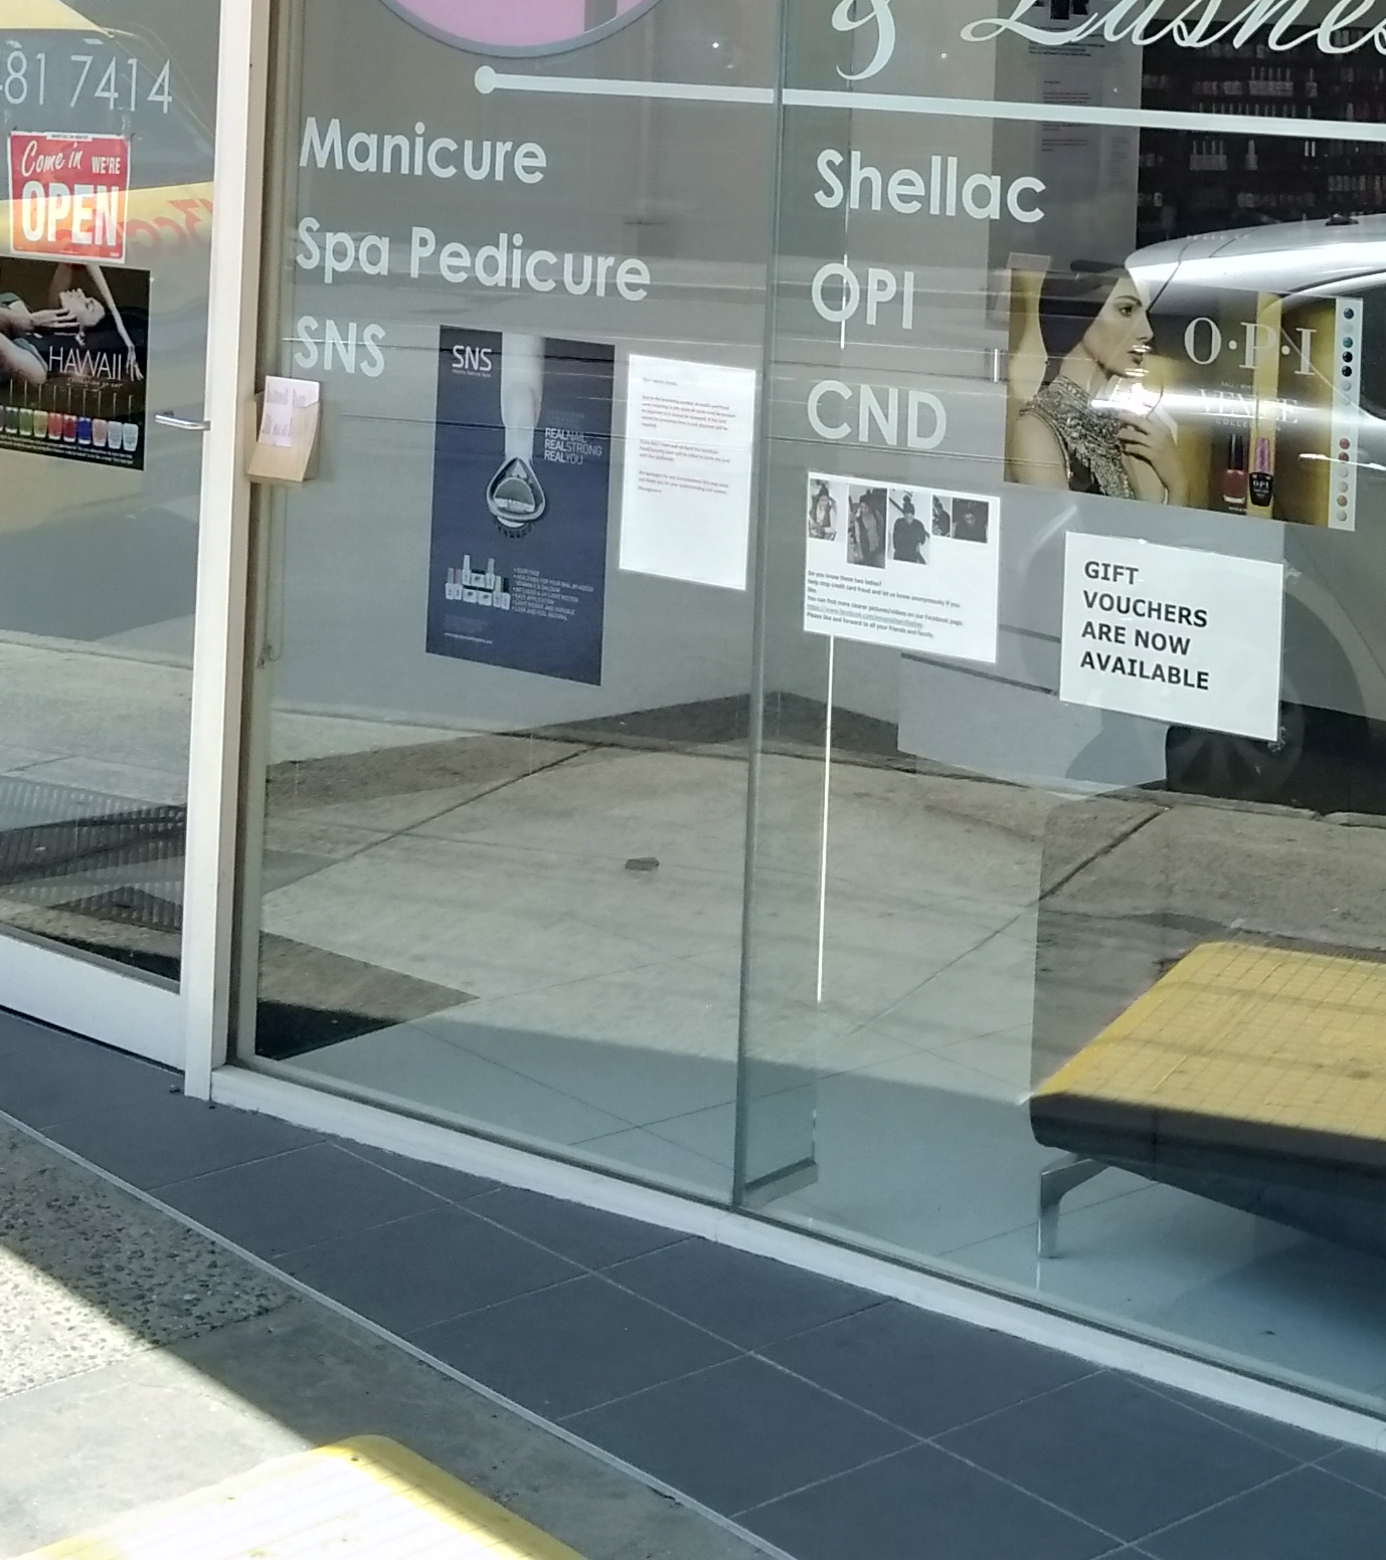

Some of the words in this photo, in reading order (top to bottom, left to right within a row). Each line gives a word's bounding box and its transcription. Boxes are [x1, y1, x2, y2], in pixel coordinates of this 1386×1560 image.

[70, 54, 173, 114] 7414
[21, 140, 65, 177] Come
[68, 142, 82, 170] in
[91, 156, 121, 174] WE'RE
[300, 116, 547, 185] Manicure
[20, 180, 119, 247] OPEN
[814, 149, 1047, 223] Shellac
[296, 216, 389, 284] Spa
[410, 226, 651, 302] Pedicure
[812, 263, 914, 330] OPI
[48, 345, 122, 380] HAWAII
[294, 315, 386, 378] SNS
[452, 344, 492, 371] SNS
[807, 381, 947, 450] CND
[1084, 560, 1139, 585] GIFT
[1081, 620, 1126, 645] ARE
[1134, 628, 1191, 656] NOW
[1083, 589, 1208, 628] VOUCHERS
[1080, 650, 1210, 690] AVAILABLE
